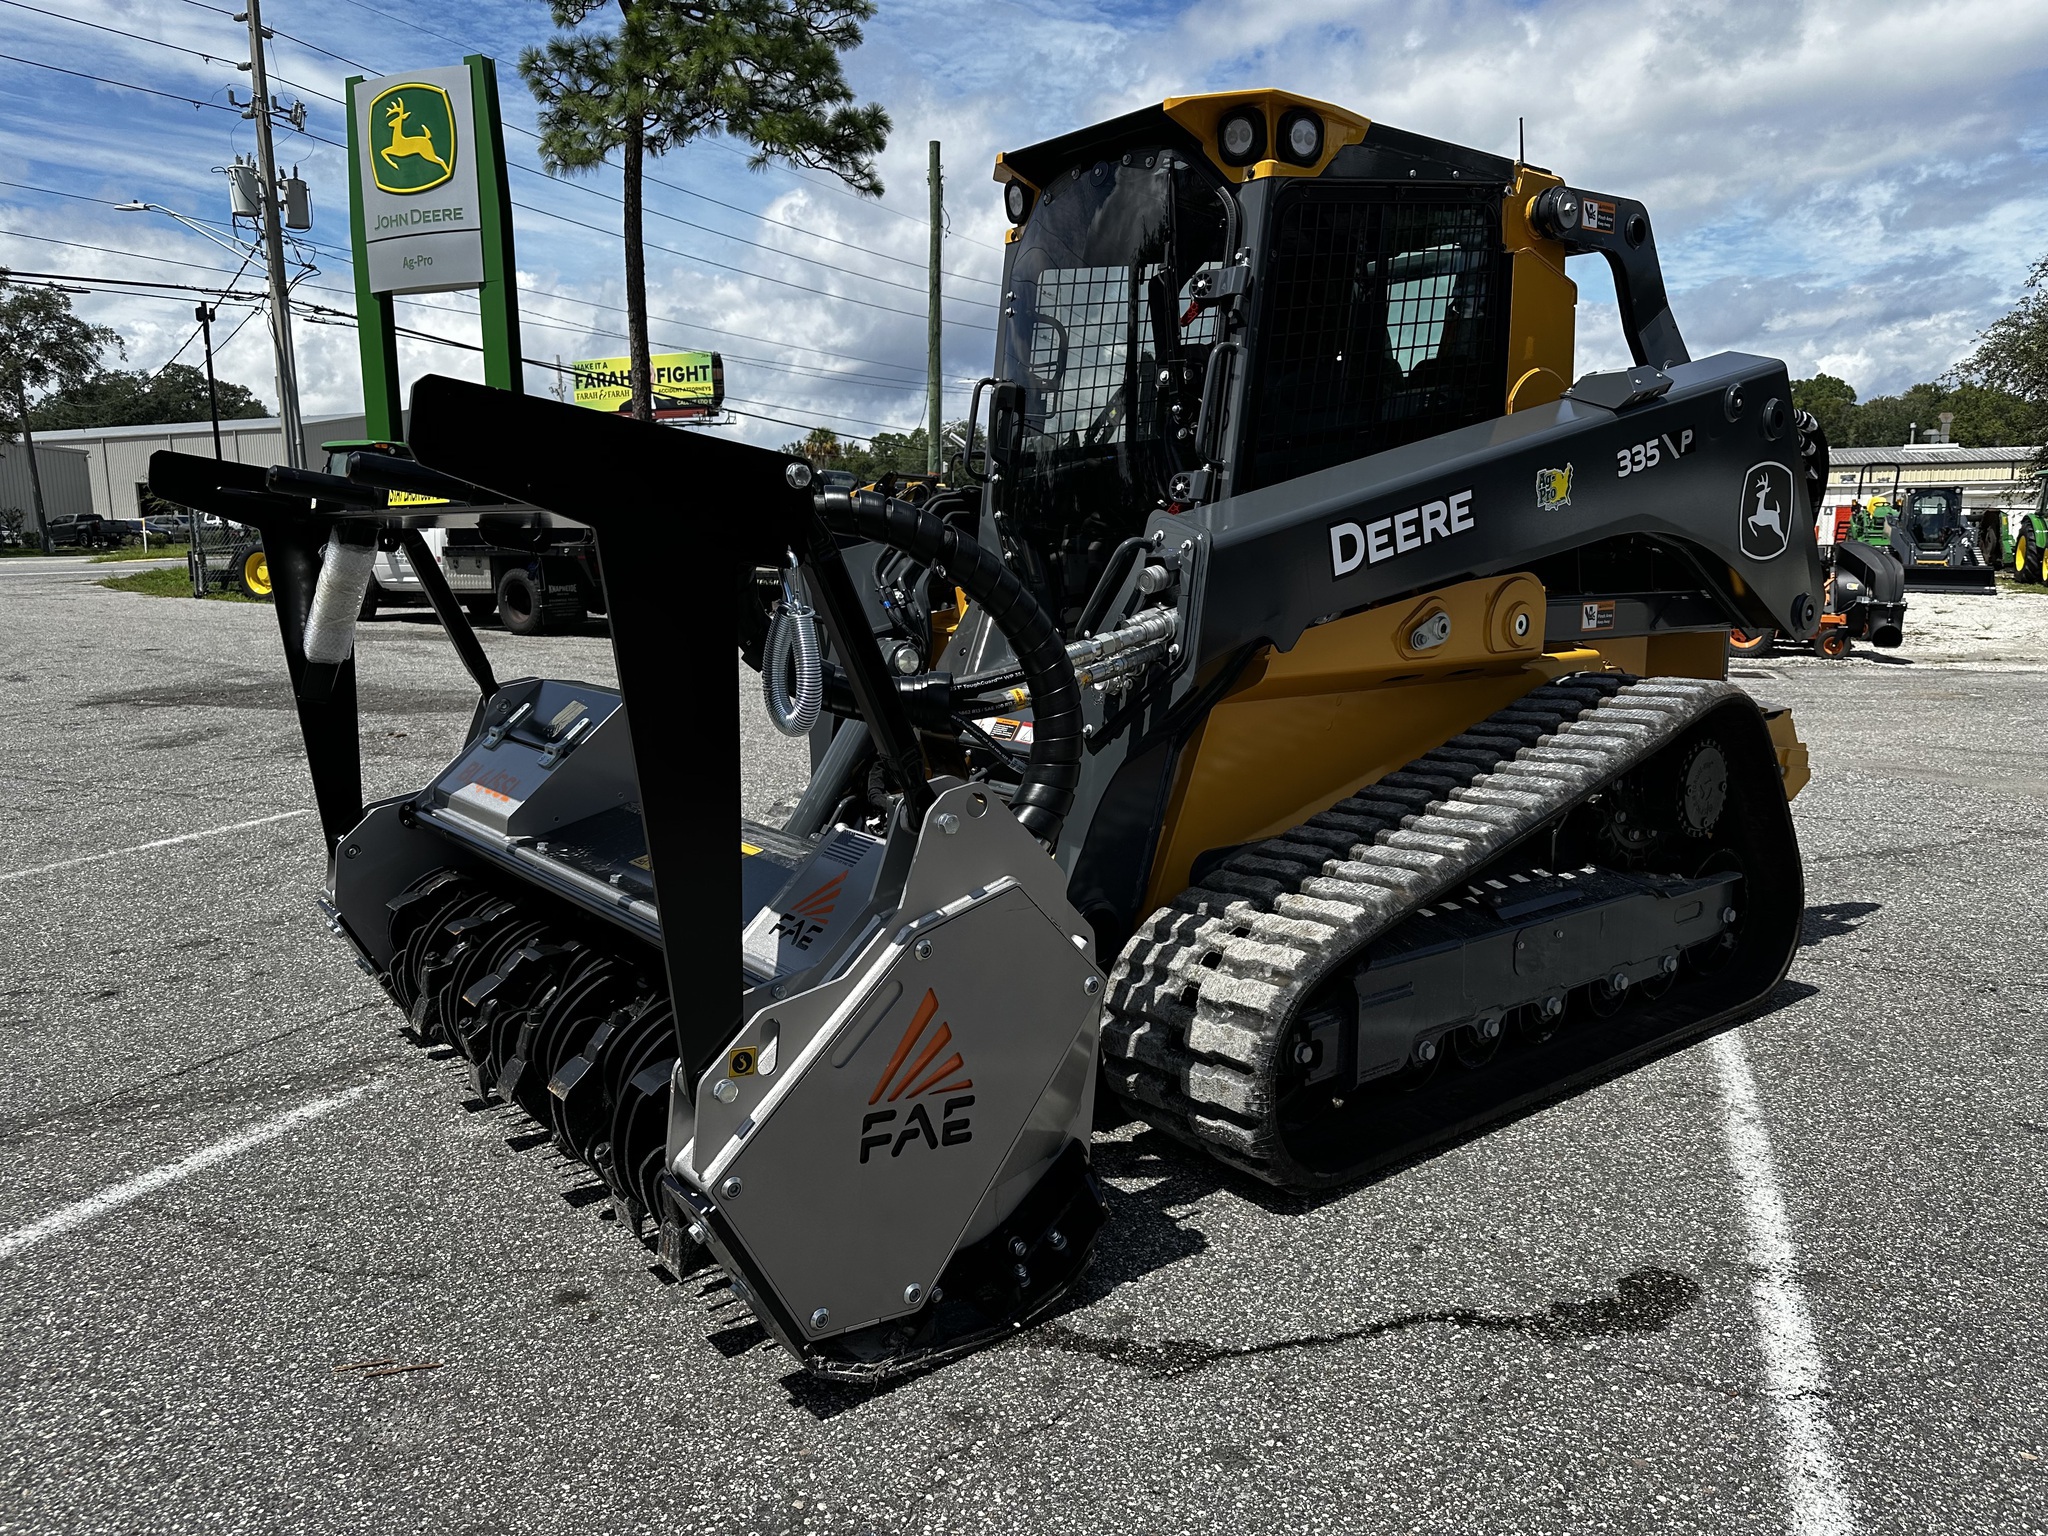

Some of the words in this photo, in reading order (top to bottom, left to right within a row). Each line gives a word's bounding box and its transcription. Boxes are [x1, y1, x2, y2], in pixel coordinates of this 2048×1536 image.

[374, 212, 408, 231] JOHN
[410, 207, 464, 225] DEERE
[402, 255, 433, 270] Ag-Pro
[574, 363, 594, 371] MAKE
[595, 362, 601, 370] IT
[575, 370, 632, 389] FARAH
[657, 365, 710, 383] FIGHT
[576, 392, 598, 400] FARAH
[608, 390, 630, 398] FARAH
[1616, 436, 1661, 478] 335
[1539, 488, 1556, 504] Pro
[1331, 490, 1475, 577] DEERE
[768, 913, 824, 951] FAE
[859, 1095, 976, 1165] FAE
